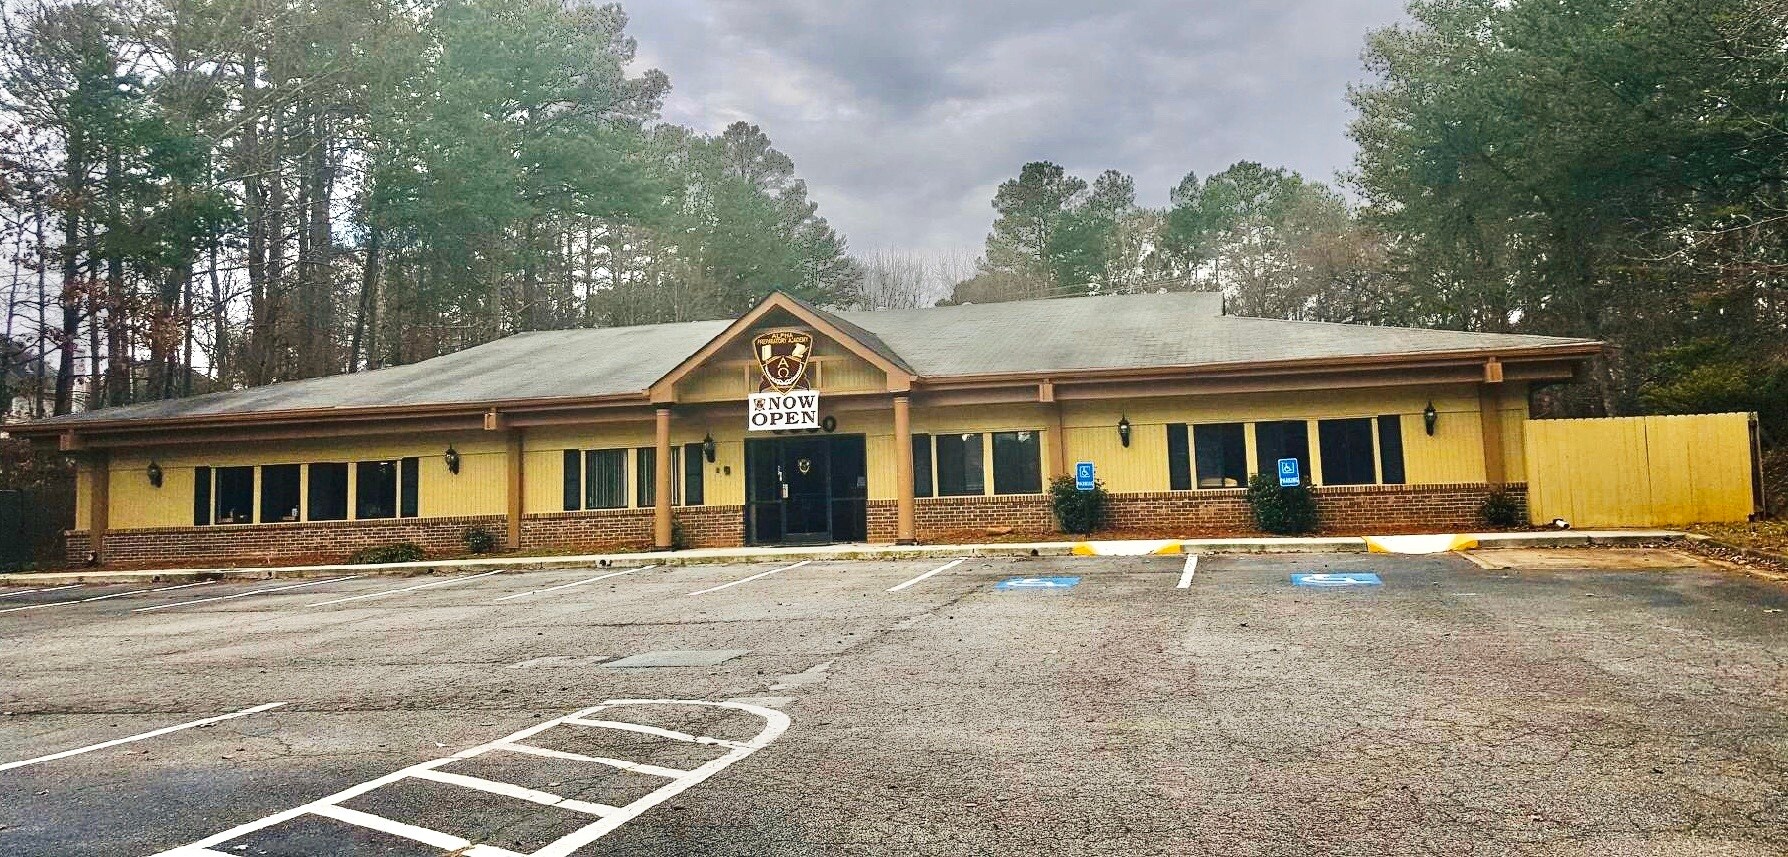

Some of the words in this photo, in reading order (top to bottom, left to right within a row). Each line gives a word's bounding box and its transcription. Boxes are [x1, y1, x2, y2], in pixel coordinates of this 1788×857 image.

[788, 336, 809, 344] ACADEMY
[768, 395, 815, 410] NOW
[751, 410, 816, 426] OPEN
